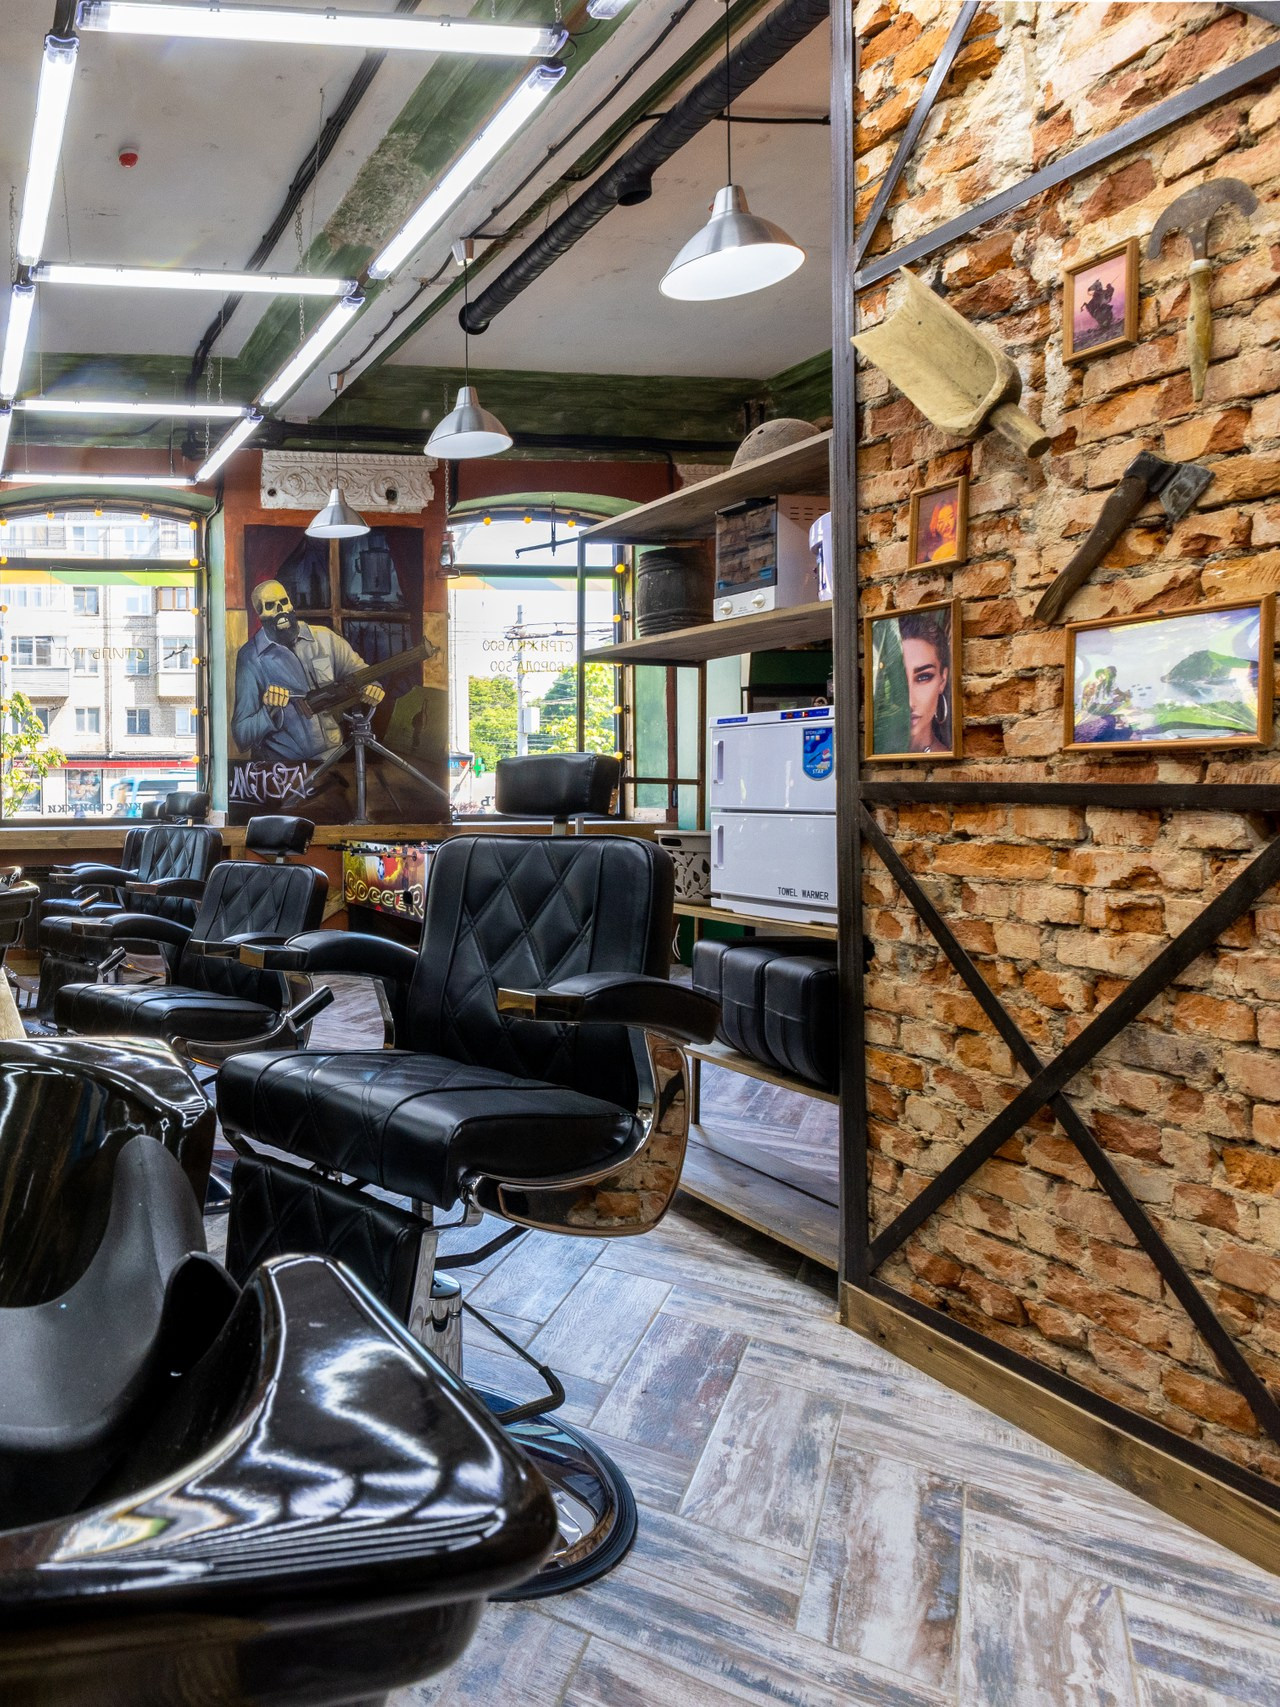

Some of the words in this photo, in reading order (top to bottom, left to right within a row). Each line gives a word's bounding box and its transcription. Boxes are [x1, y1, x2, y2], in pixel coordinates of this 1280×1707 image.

[345, 869, 425, 920] SOCCER
[777, 886, 798, 897] TOWEL
[801, 889, 829, 901] WARMER
